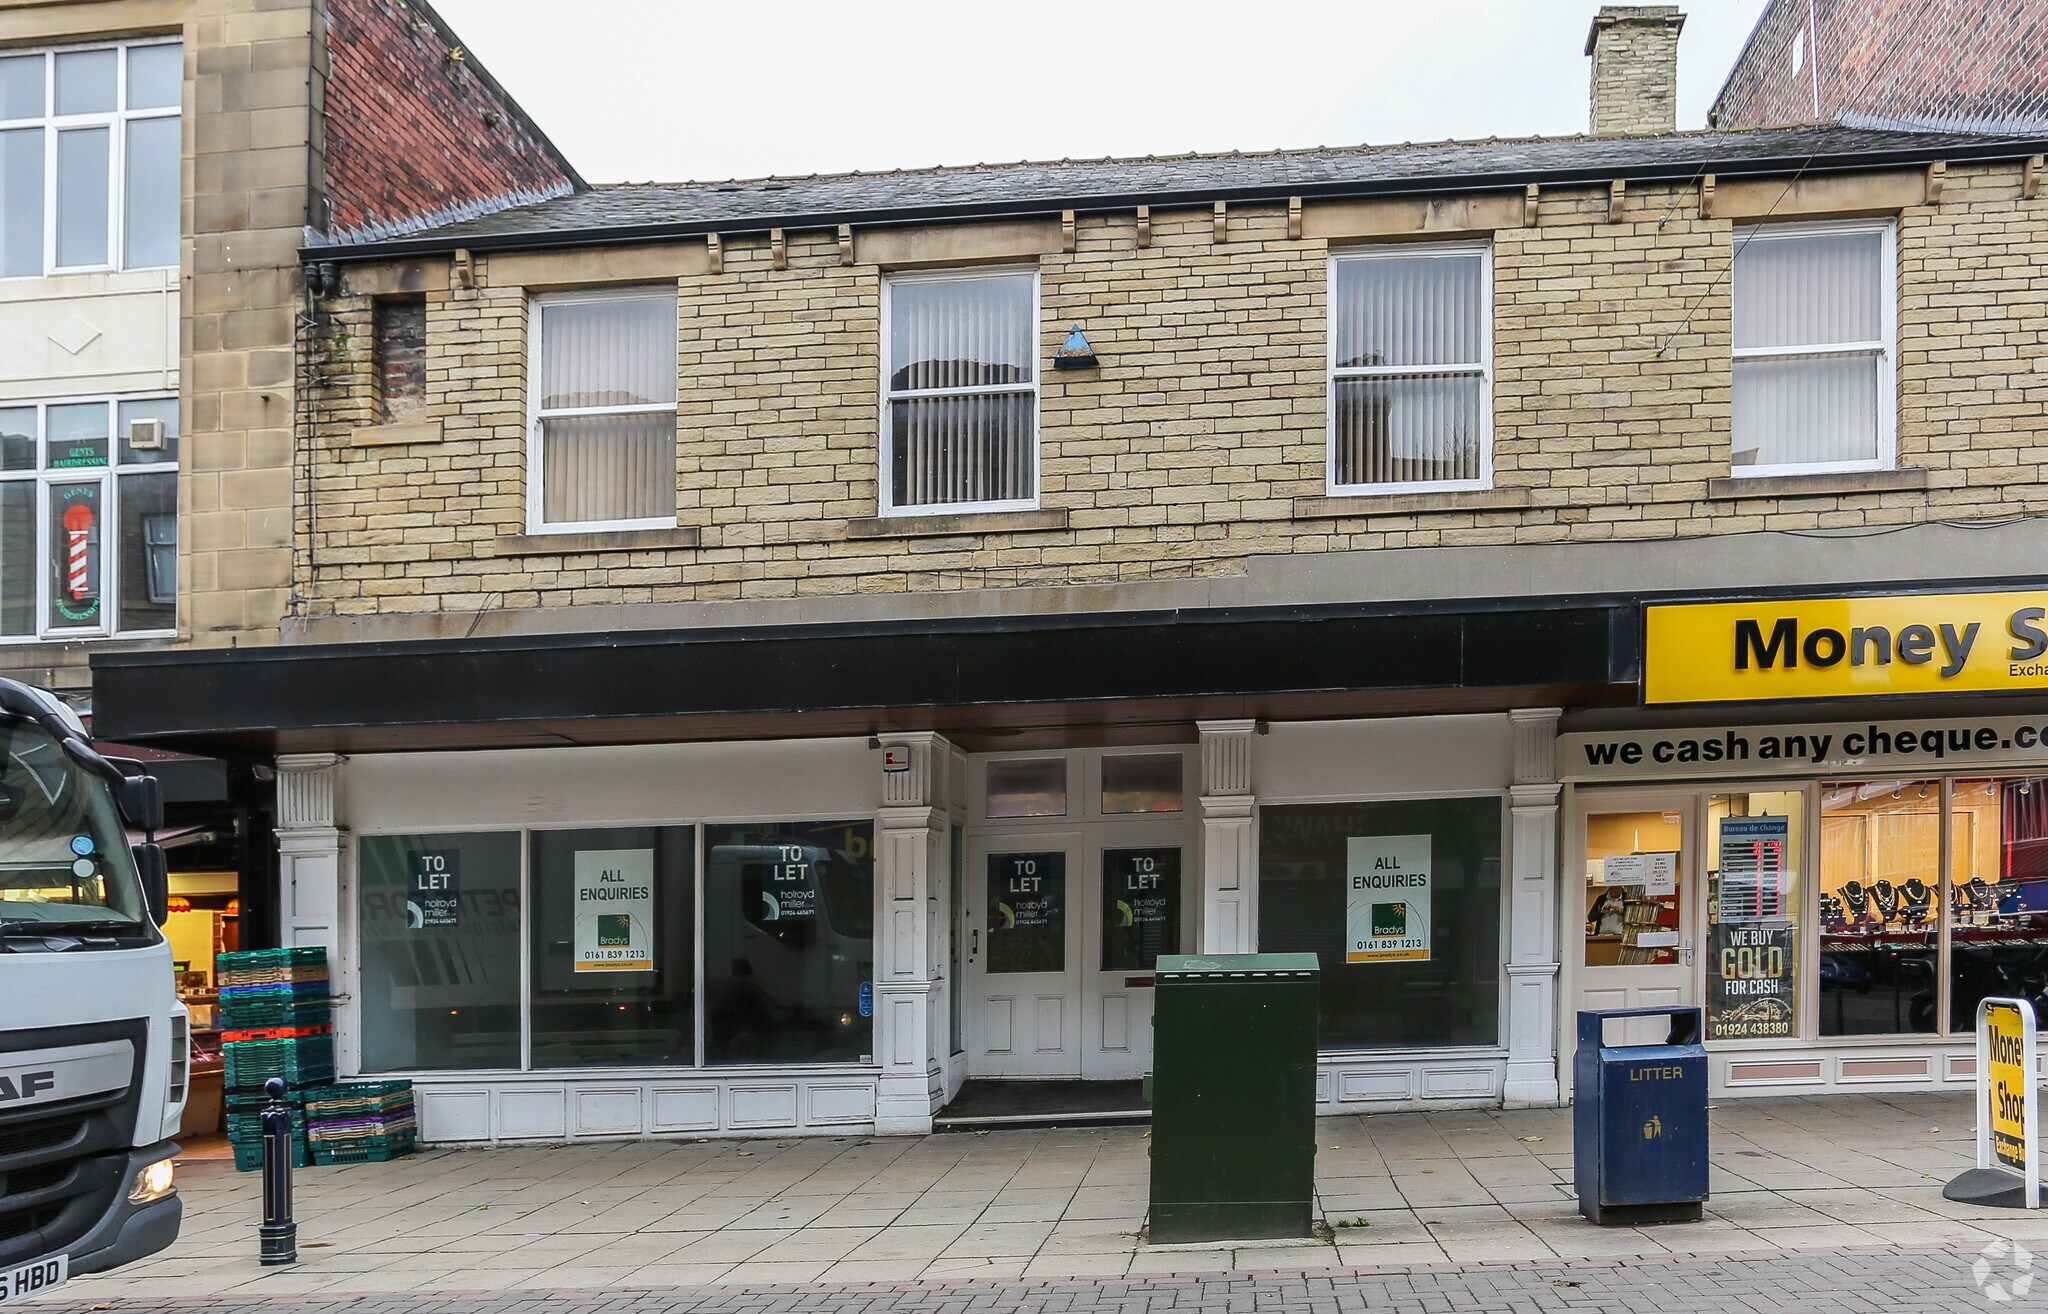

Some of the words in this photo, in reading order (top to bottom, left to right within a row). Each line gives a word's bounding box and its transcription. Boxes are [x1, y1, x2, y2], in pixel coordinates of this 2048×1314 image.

[69, 447, 95, 457] GENTS
[64, 487, 95, 500] GENTS
[1735, 617, 1981, 677] Money
[1584, 741, 1643, 766] we
[1652, 731, 1749, 764] cash
[1758, 734, 1833, 764] any
[1760, 824, 1785, 833] Change
[779, 846, 802, 861] TO
[422, 856, 444, 871] TO
[1014, 860, 1036, 875] TO
[1132, 857, 1154, 872] TO
[1374, 856, 1401, 870] ALL
[600, 870, 625, 882] ALL
[774, 864, 808, 880] LET
[418, 874, 450, 889] LET
[1010, 877, 1041, 892] LET
[1128, 874, 1160, 889] LET
[1353, 873, 1427, 889] ENQUIRIES
[580, 887, 649, 901] ENQUIRIES
[781, 889, 815, 900] holroyd
[424, 898, 457, 908] holroyd
[1016, 900, 1048, 909] holroyd
[1134, 898, 1166, 907] holroyd
[1374, 925, 1404, 935] Bradys
[600, 936, 628, 946] Bradys
[1357, 941, 1378, 950] 0161
[1381, 940, 1397, 949] 839
[1401, 939, 1422, 948] 1213
[1730, 931, 1748, 946] WE
[1751, 930, 1773, 945] BUY
[584, 951, 604, 959] 0161
[607, 950, 622, 959] 839
[626, 950, 645, 958] 1213
[1721, 946, 1783, 979] GOLD
[1725, 980, 1746, 995] FOR
[1749, 979, 1778, 994] CASH
[1715, 1023, 1748, 1036] 01924
[1750, 1022, 1788, 1035] 438380
[1630, 1067, 1683, 1081] LITTER
[15, 1261, 59, 1295] HBD
